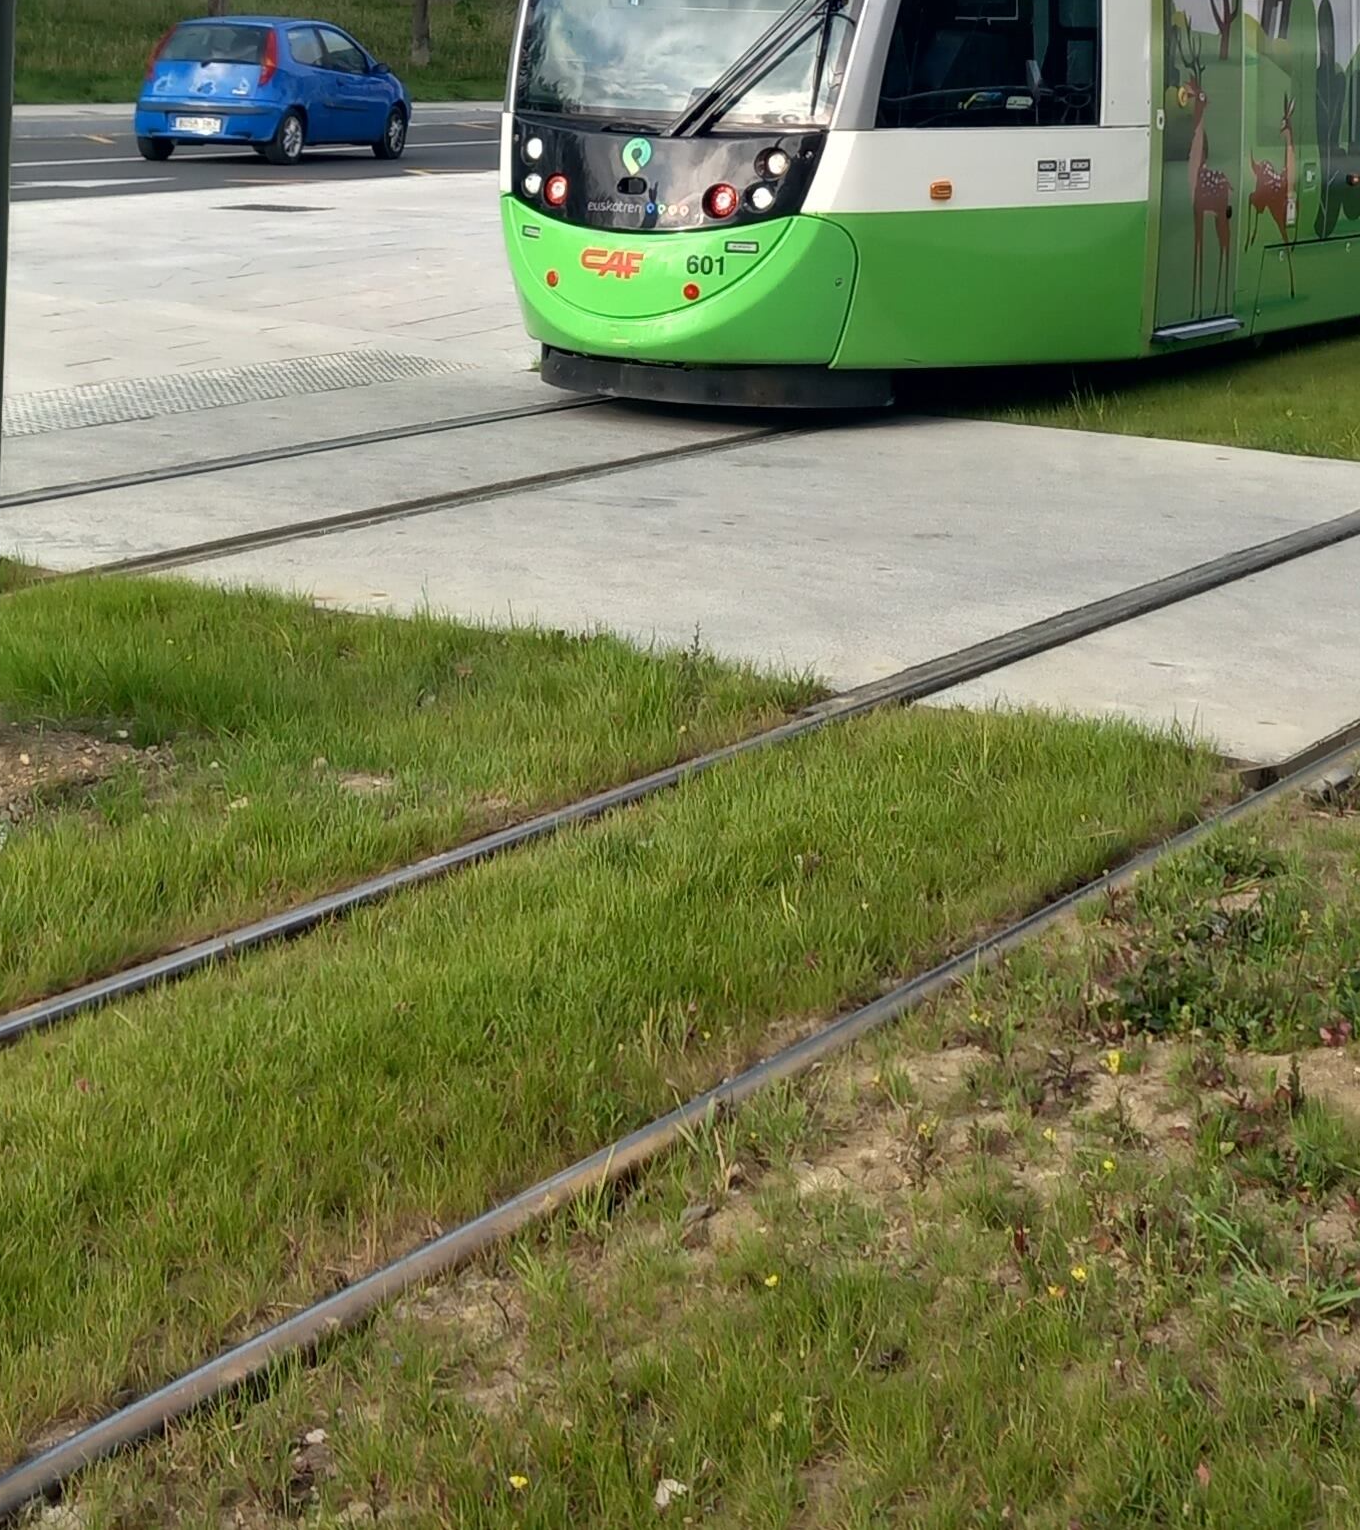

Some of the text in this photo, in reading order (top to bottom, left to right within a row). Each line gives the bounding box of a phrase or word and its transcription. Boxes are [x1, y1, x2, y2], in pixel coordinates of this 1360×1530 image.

[587, 200, 642, 214] euskotren
[581, 249, 644, 279] CAF
[686, 256, 726, 276] 601
